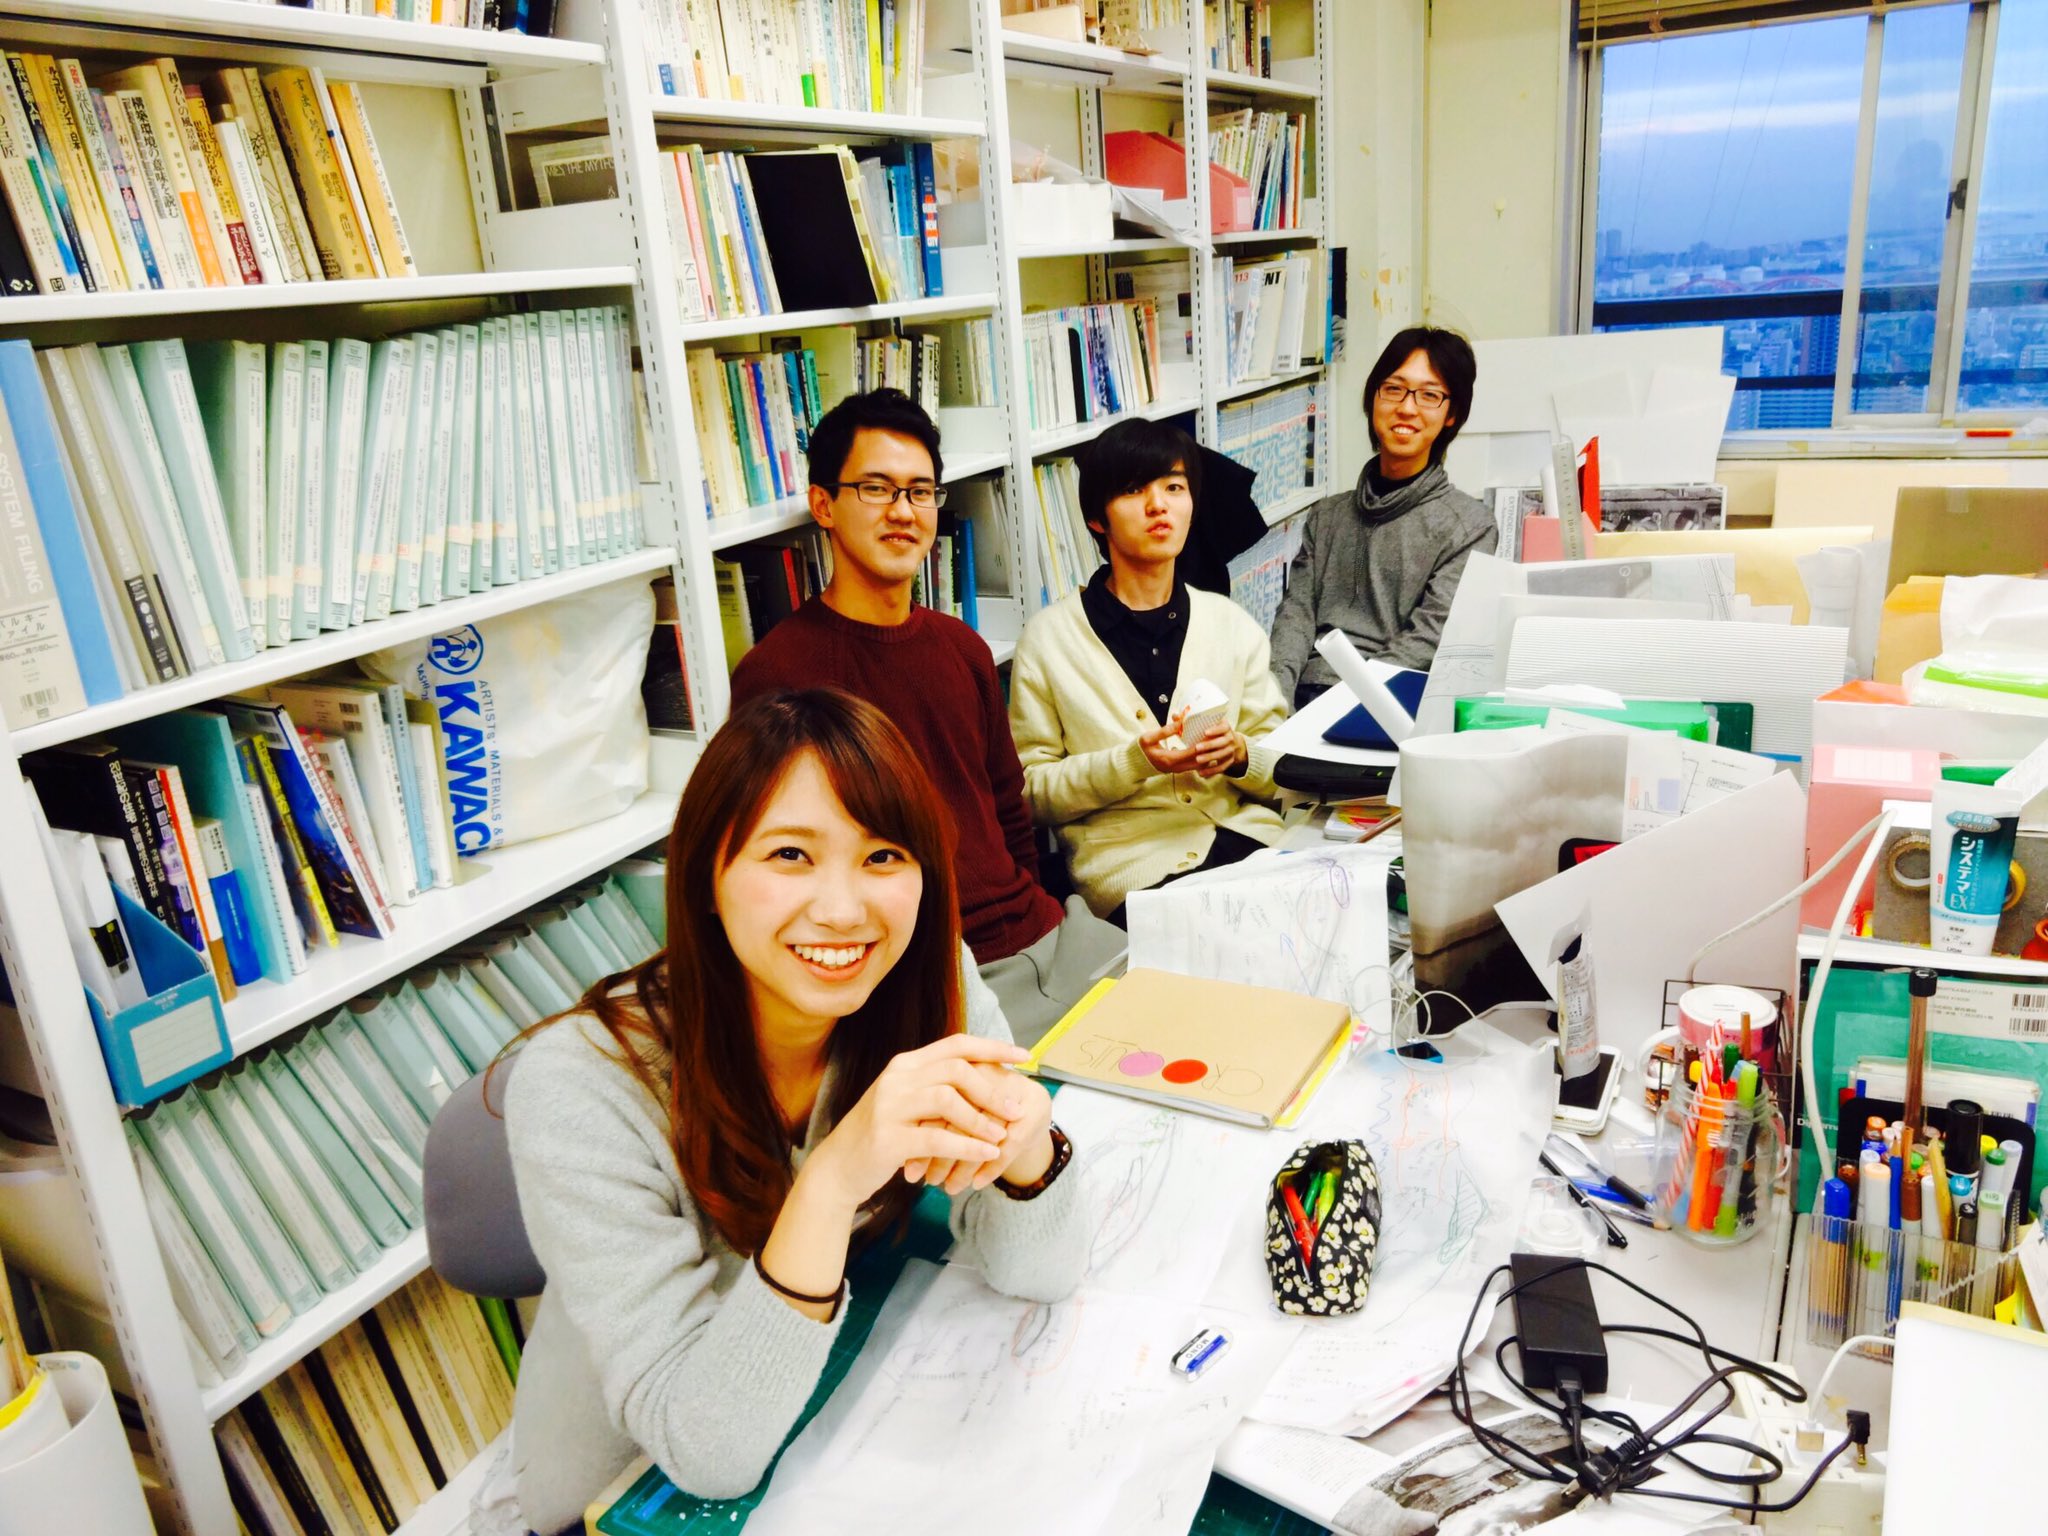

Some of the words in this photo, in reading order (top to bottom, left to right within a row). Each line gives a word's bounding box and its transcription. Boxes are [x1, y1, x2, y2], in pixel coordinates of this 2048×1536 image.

[248, 200, 267, 245] LEOPOLD
[15, 534, 44, 595] FILING
[478, 679, 497, 744] ARTISTS'
[490, 749, 502, 822] MATERIALS
[1956, 836, 1976, 895] システマ
[1949, 893, 1968, 910] EX
[1184, 1338, 1210, 1359] MONO
